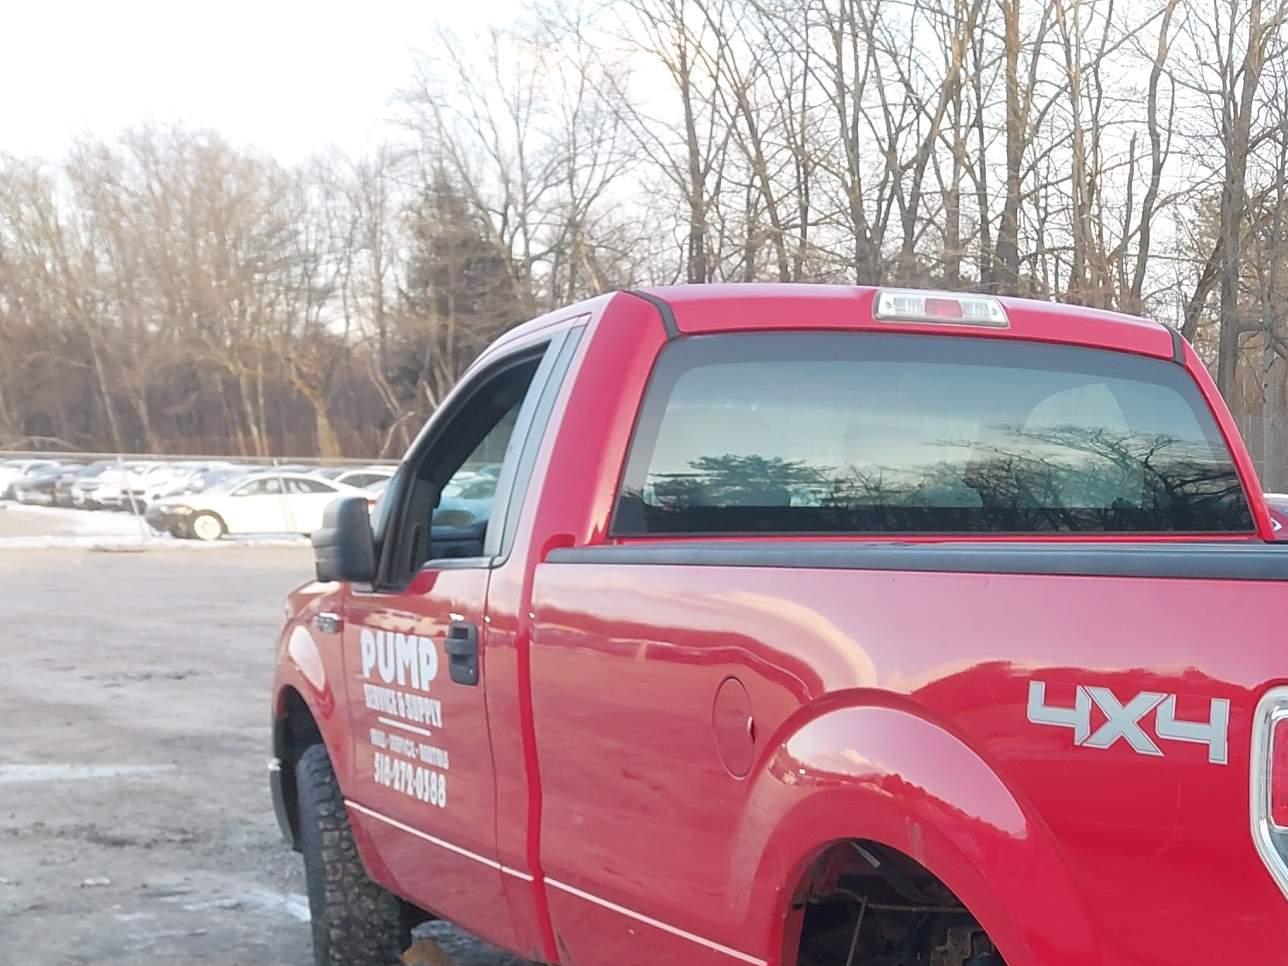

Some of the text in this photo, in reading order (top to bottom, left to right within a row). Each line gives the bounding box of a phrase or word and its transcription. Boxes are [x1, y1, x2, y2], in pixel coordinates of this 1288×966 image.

[360, 627, 438, 692] PUMP
[405, 692, 442, 729] SUPPLY
[1027, 680, 1230, 765] 4X4
